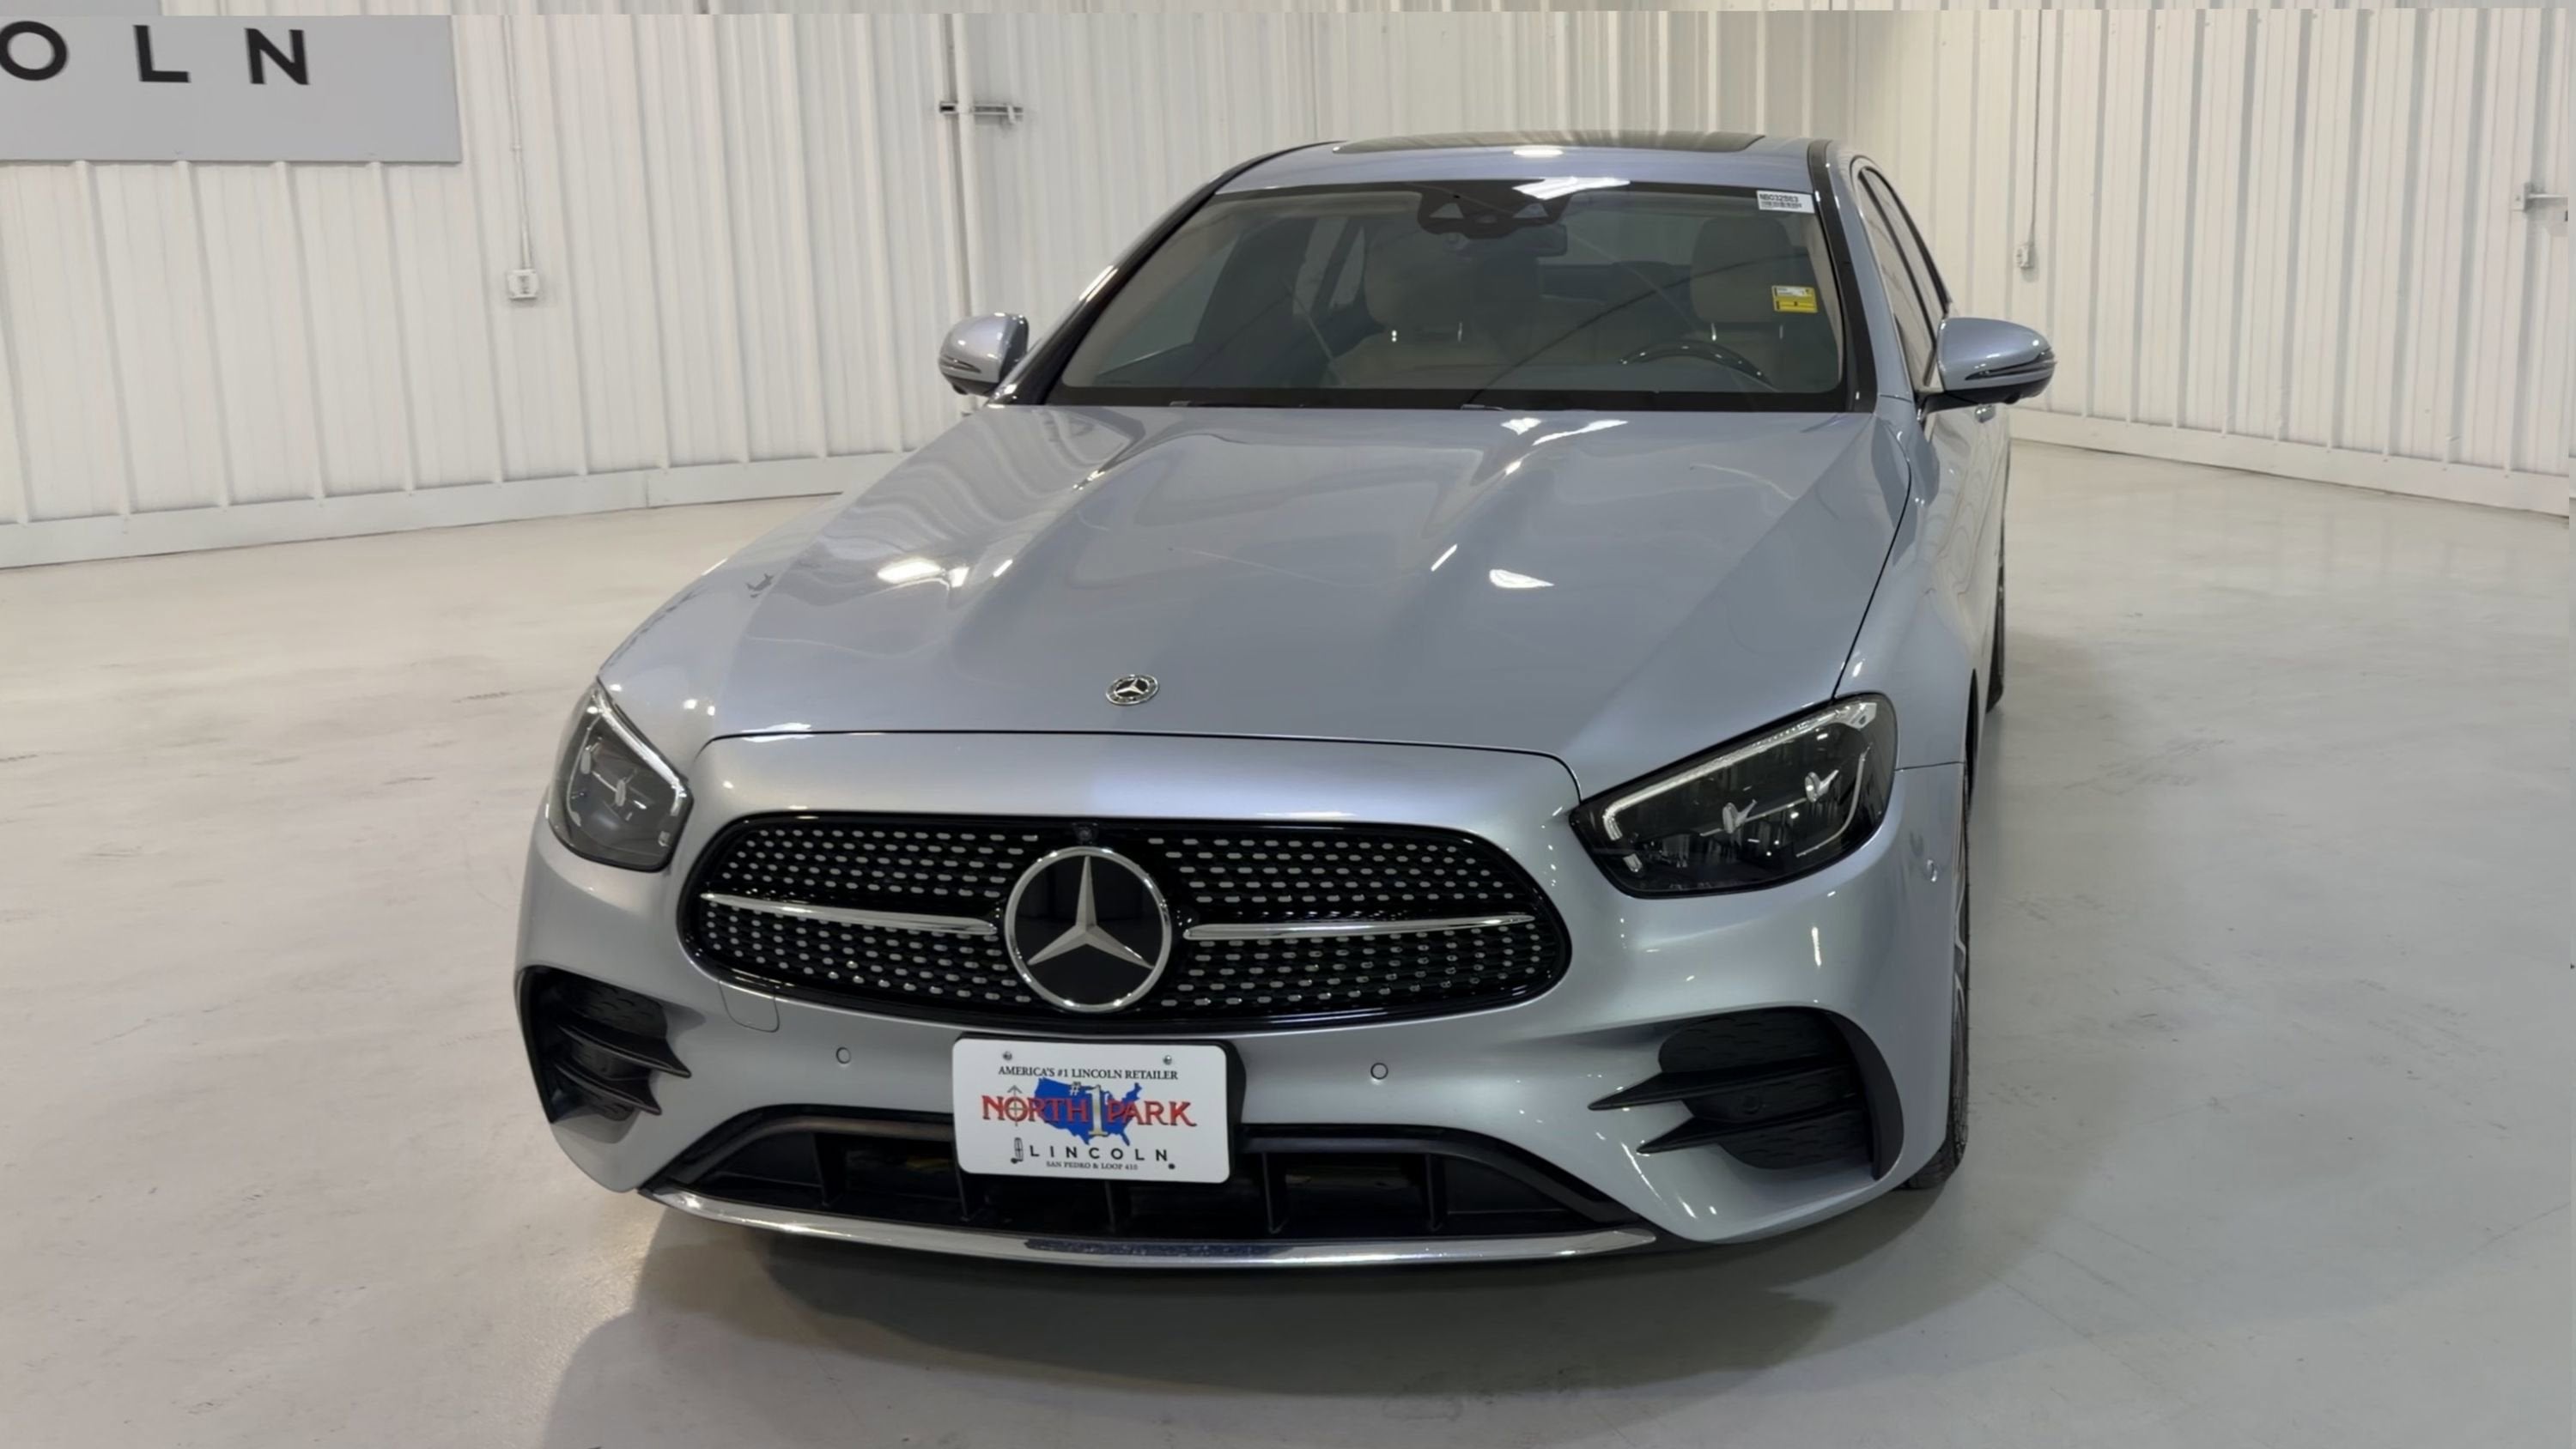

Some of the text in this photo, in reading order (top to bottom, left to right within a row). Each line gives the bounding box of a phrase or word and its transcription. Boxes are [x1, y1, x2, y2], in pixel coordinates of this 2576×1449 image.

[999, 1066, 1178, 1080] AMERICA'S #1 LINCOLN RETAILER
[981, 1095, 1197, 1127] NORTH PARK
[1030, 1145, 1168, 1161] LINCOLN
